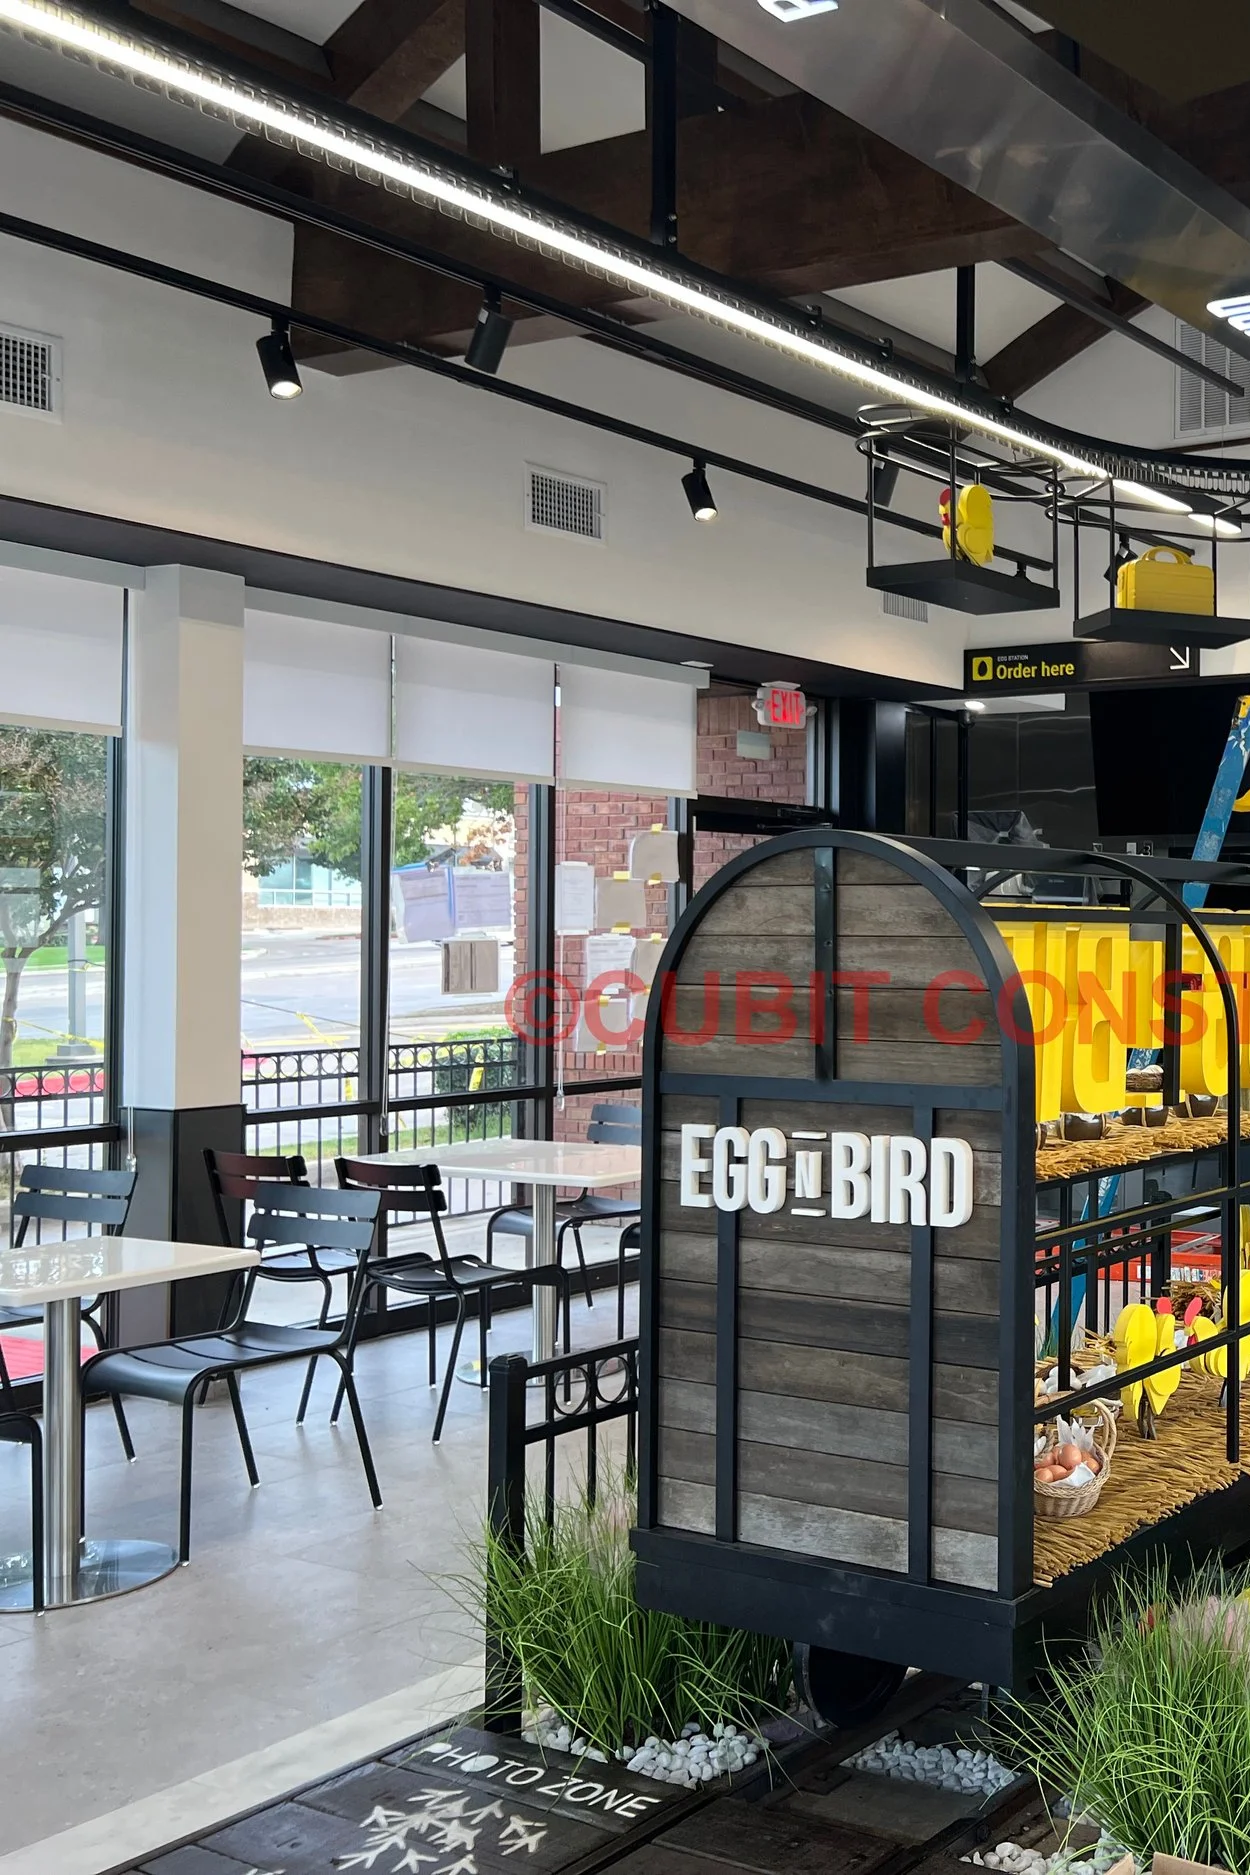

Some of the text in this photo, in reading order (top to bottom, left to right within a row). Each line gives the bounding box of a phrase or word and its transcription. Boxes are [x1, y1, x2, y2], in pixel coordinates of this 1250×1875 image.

[996, 660, 1075, 680] Order here
[770, 688, 801, 726] EXIT
[680, 1123, 788, 1215] EGG
[831, 1131, 975, 1228] BIRD
[418, 1741, 662, 1819] PHOTO ZONE
